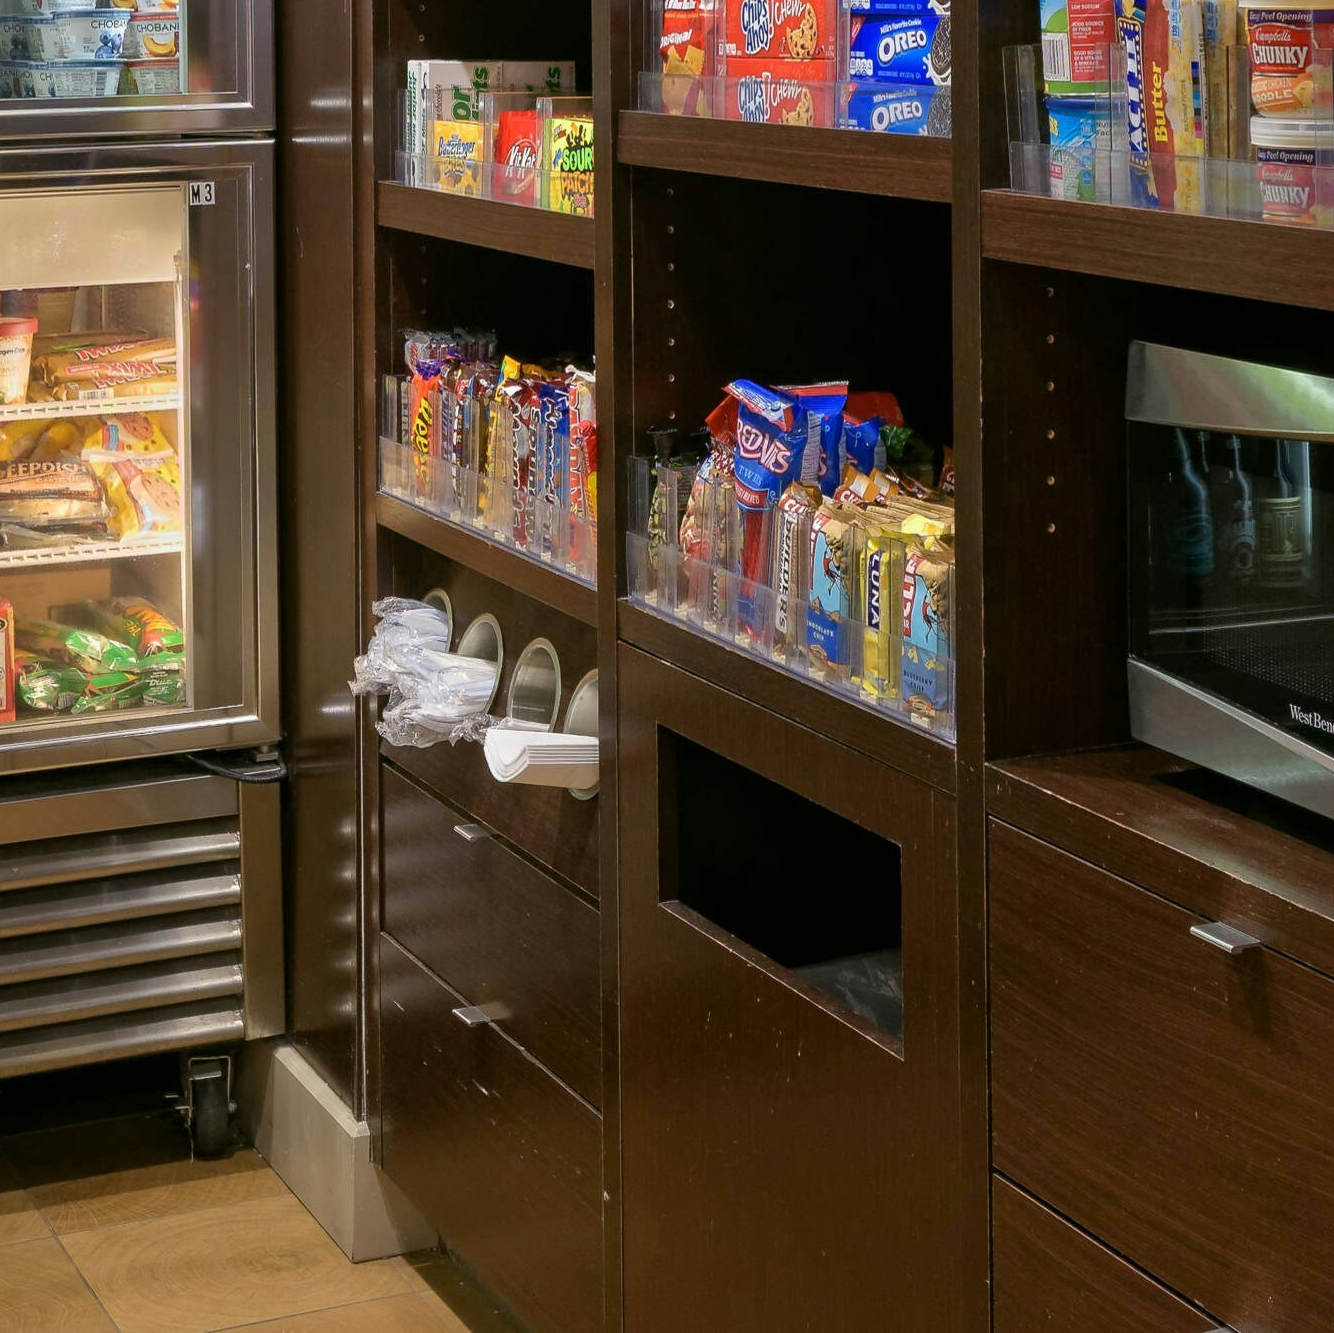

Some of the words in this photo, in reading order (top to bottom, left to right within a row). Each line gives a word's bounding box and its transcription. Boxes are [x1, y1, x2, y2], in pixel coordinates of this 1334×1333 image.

[895, 21, 910, 31] Favorite
[909, 18, 922, 27] Cookie
[1260, 11, 1276, 21] Peel
[1275, 11, 1313, 23] Opening
[877, 29, 928, 59] OREO
[1252, 45, 1310, 69] CHUNKY
[1151, 60, 1169, 143] Butter
[871, 101, 923, 132] OREO
[1127, 83, 1145, 153] ACT
[437, 136, 476, 157] Butterfinger
[1279, 151, 1314, 163] Opening
[562, 147, 594, 172] SOUR
[560, 171, 594, 196] PATCH
[1259, 182, 1310, 209] CHUNKY
[868, 550, 882, 625] LUNA
[1288, 703, 1313, 726] West
